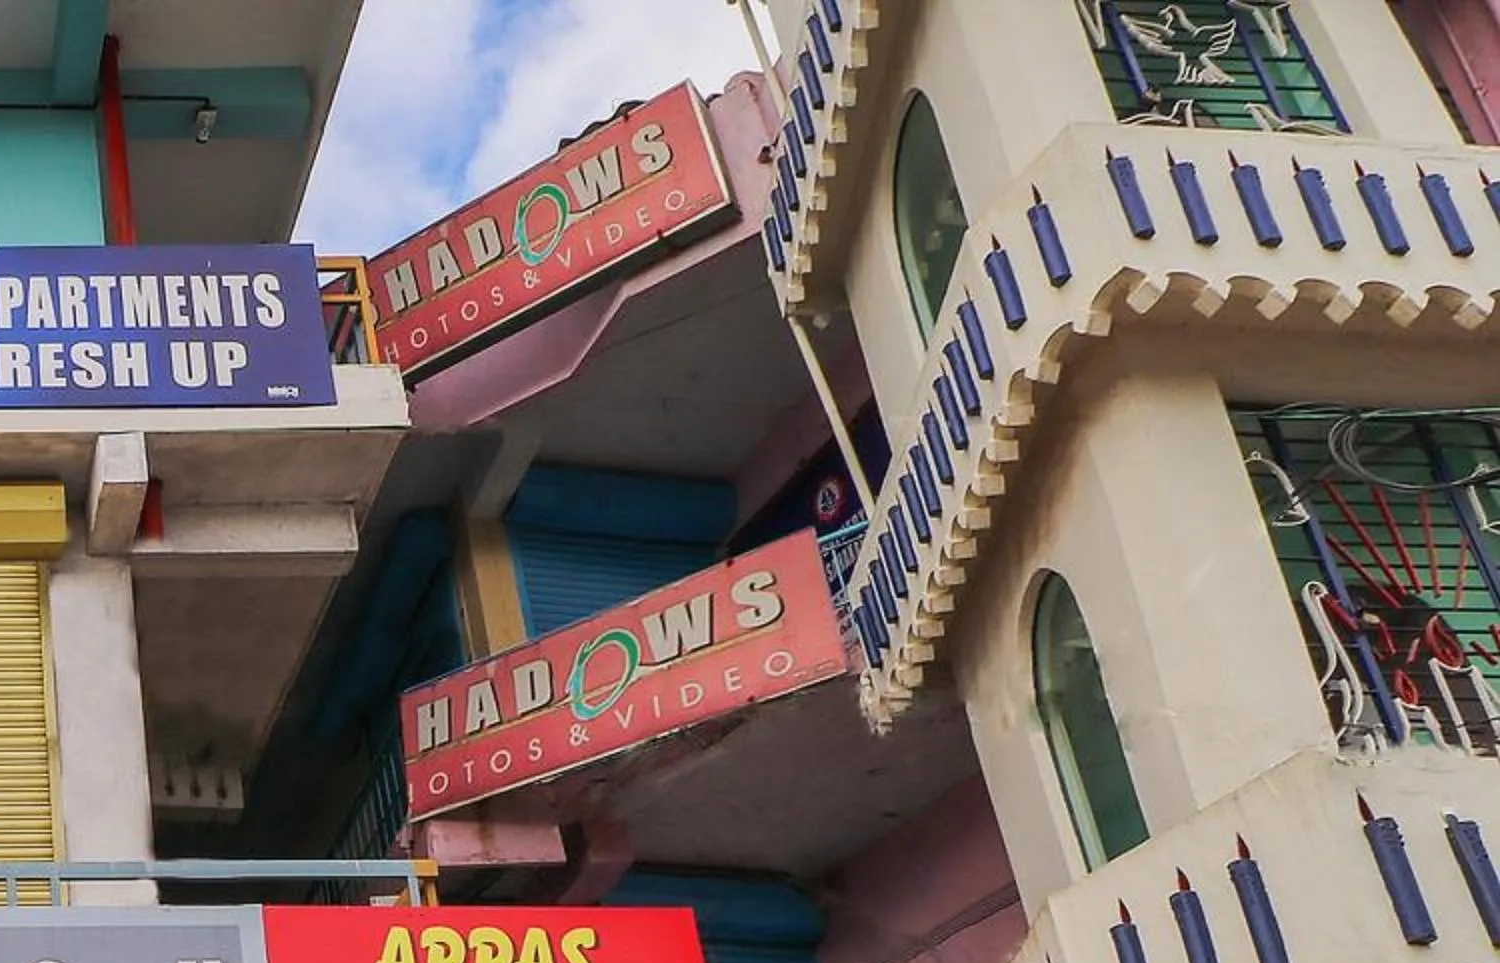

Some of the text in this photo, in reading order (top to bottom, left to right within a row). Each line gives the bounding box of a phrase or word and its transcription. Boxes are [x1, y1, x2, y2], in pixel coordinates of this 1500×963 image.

[367, 122, 674, 326] HADOWS
[522, 268, 542, 290] &
[554, 189, 687, 270] VIDEO
[170, 340, 250, 387] UP
[408, 650, 796, 803] OTOS & VIDEO
[417, 569, 784, 752] HADOWS
